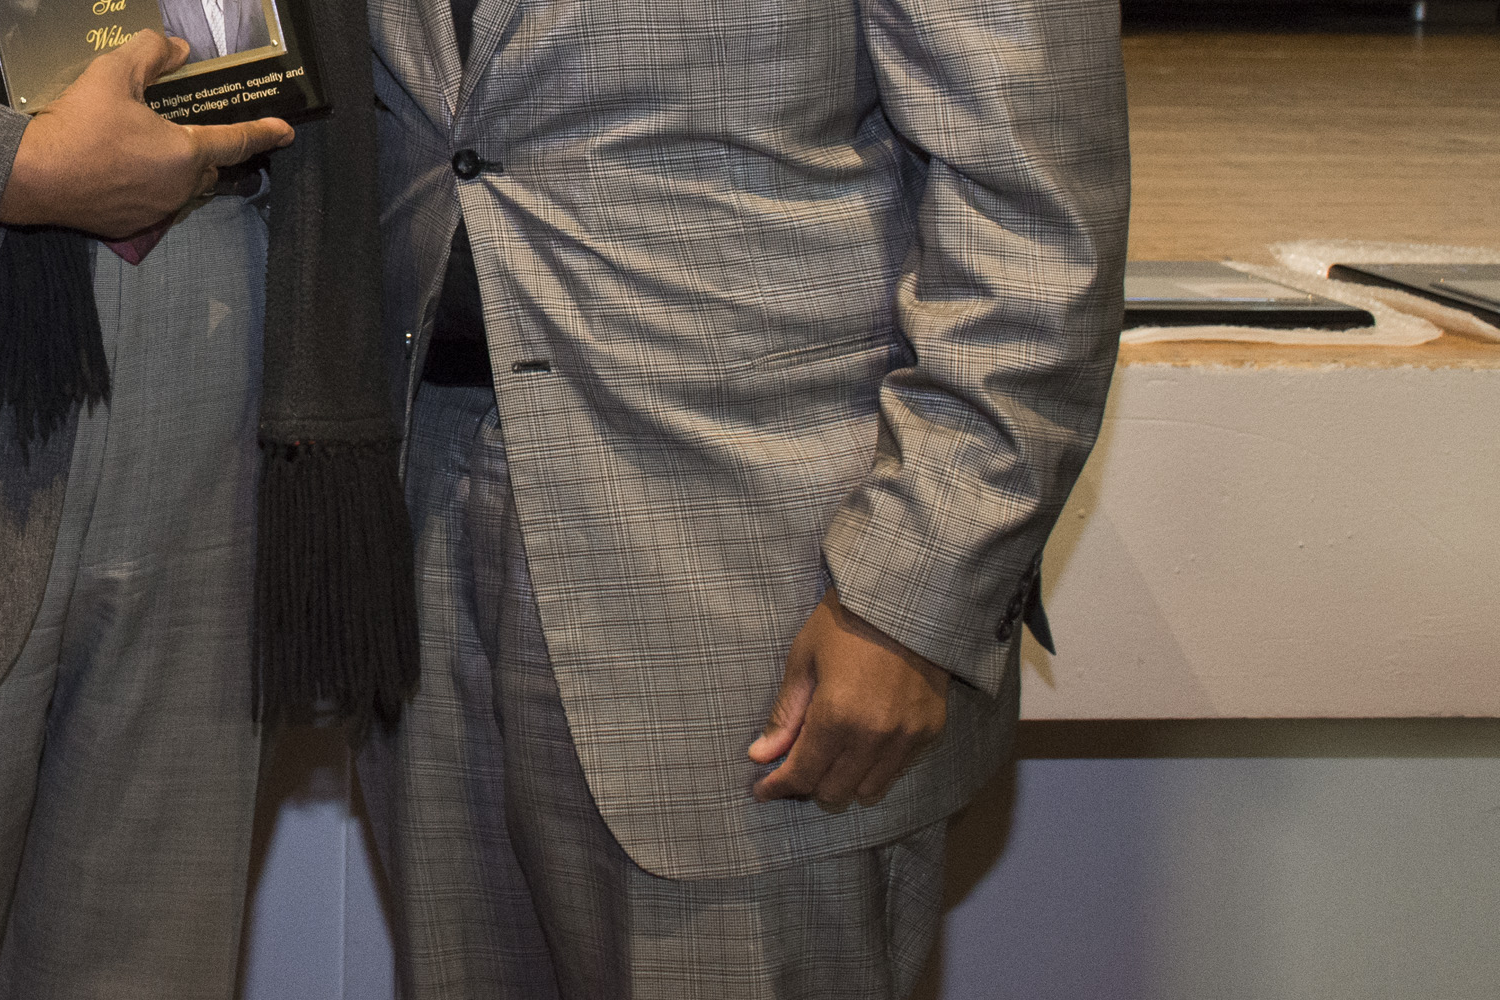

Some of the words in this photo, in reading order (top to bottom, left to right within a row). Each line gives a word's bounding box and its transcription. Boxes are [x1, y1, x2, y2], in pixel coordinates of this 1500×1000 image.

[150, 100, 161, 110] to
[162, 92, 193, 108] higher
[194, 81, 245, 100] education,
[246, 71, 284, 89] equality
[285, 66, 304, 79] and
[192, 98, 229, 114] College
[231, 94, 241, 104] of
[242, 86, 280, 101] Denver.
